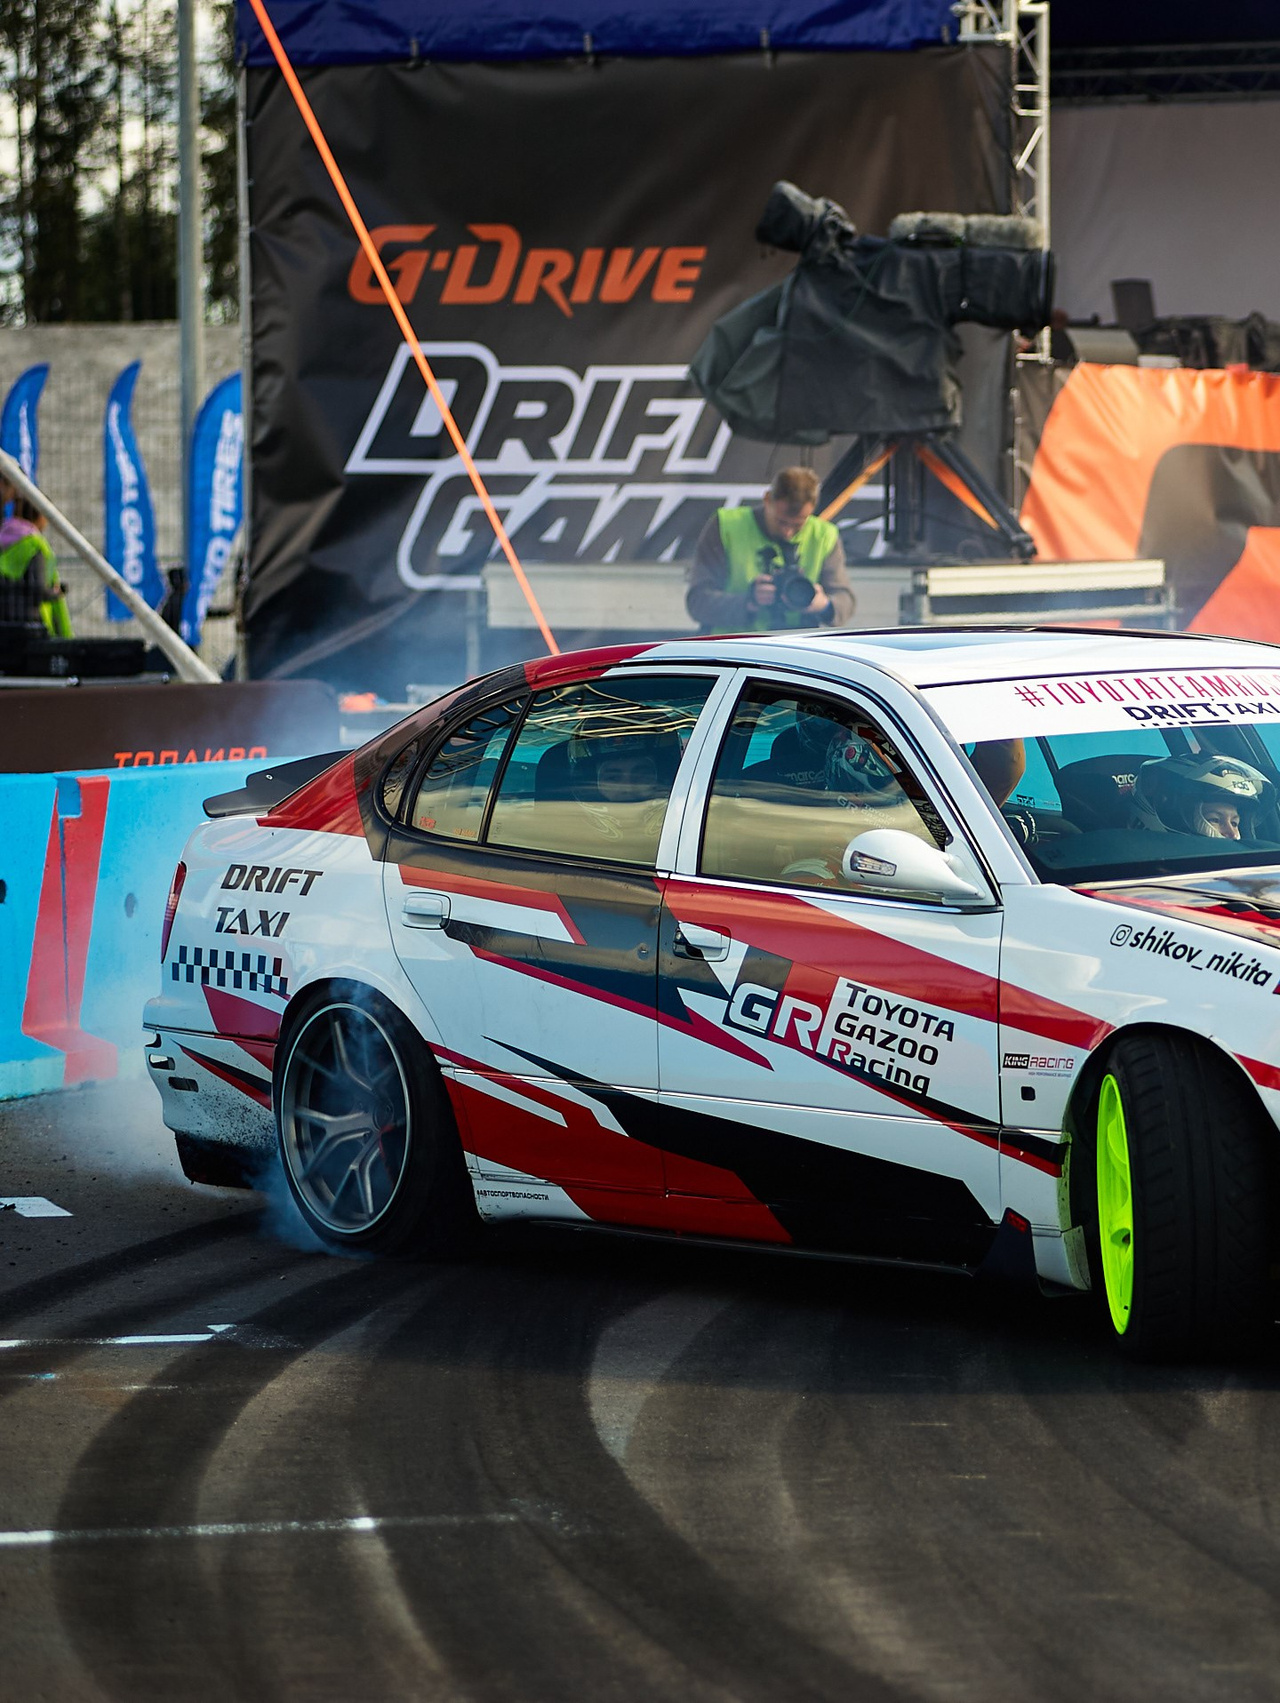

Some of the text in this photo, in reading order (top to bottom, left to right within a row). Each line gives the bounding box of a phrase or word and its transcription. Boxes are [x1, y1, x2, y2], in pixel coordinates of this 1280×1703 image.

[1122, 702, 1226, 721] DRIFT
[220, 863, 324, 897] DRIFT
[214, 906, 290, 938] TAXI
[1129, 925, 1273, 987] shikov_nikita
[728, 982, 824, 1051] GR
[833, 1012, 939, 1066] GAZOO
[845, 982, 955, 1042] TOYOTA
[827, 1037, 931, 1097] Racing
[1004, 1055, 1029, 1067] KING
